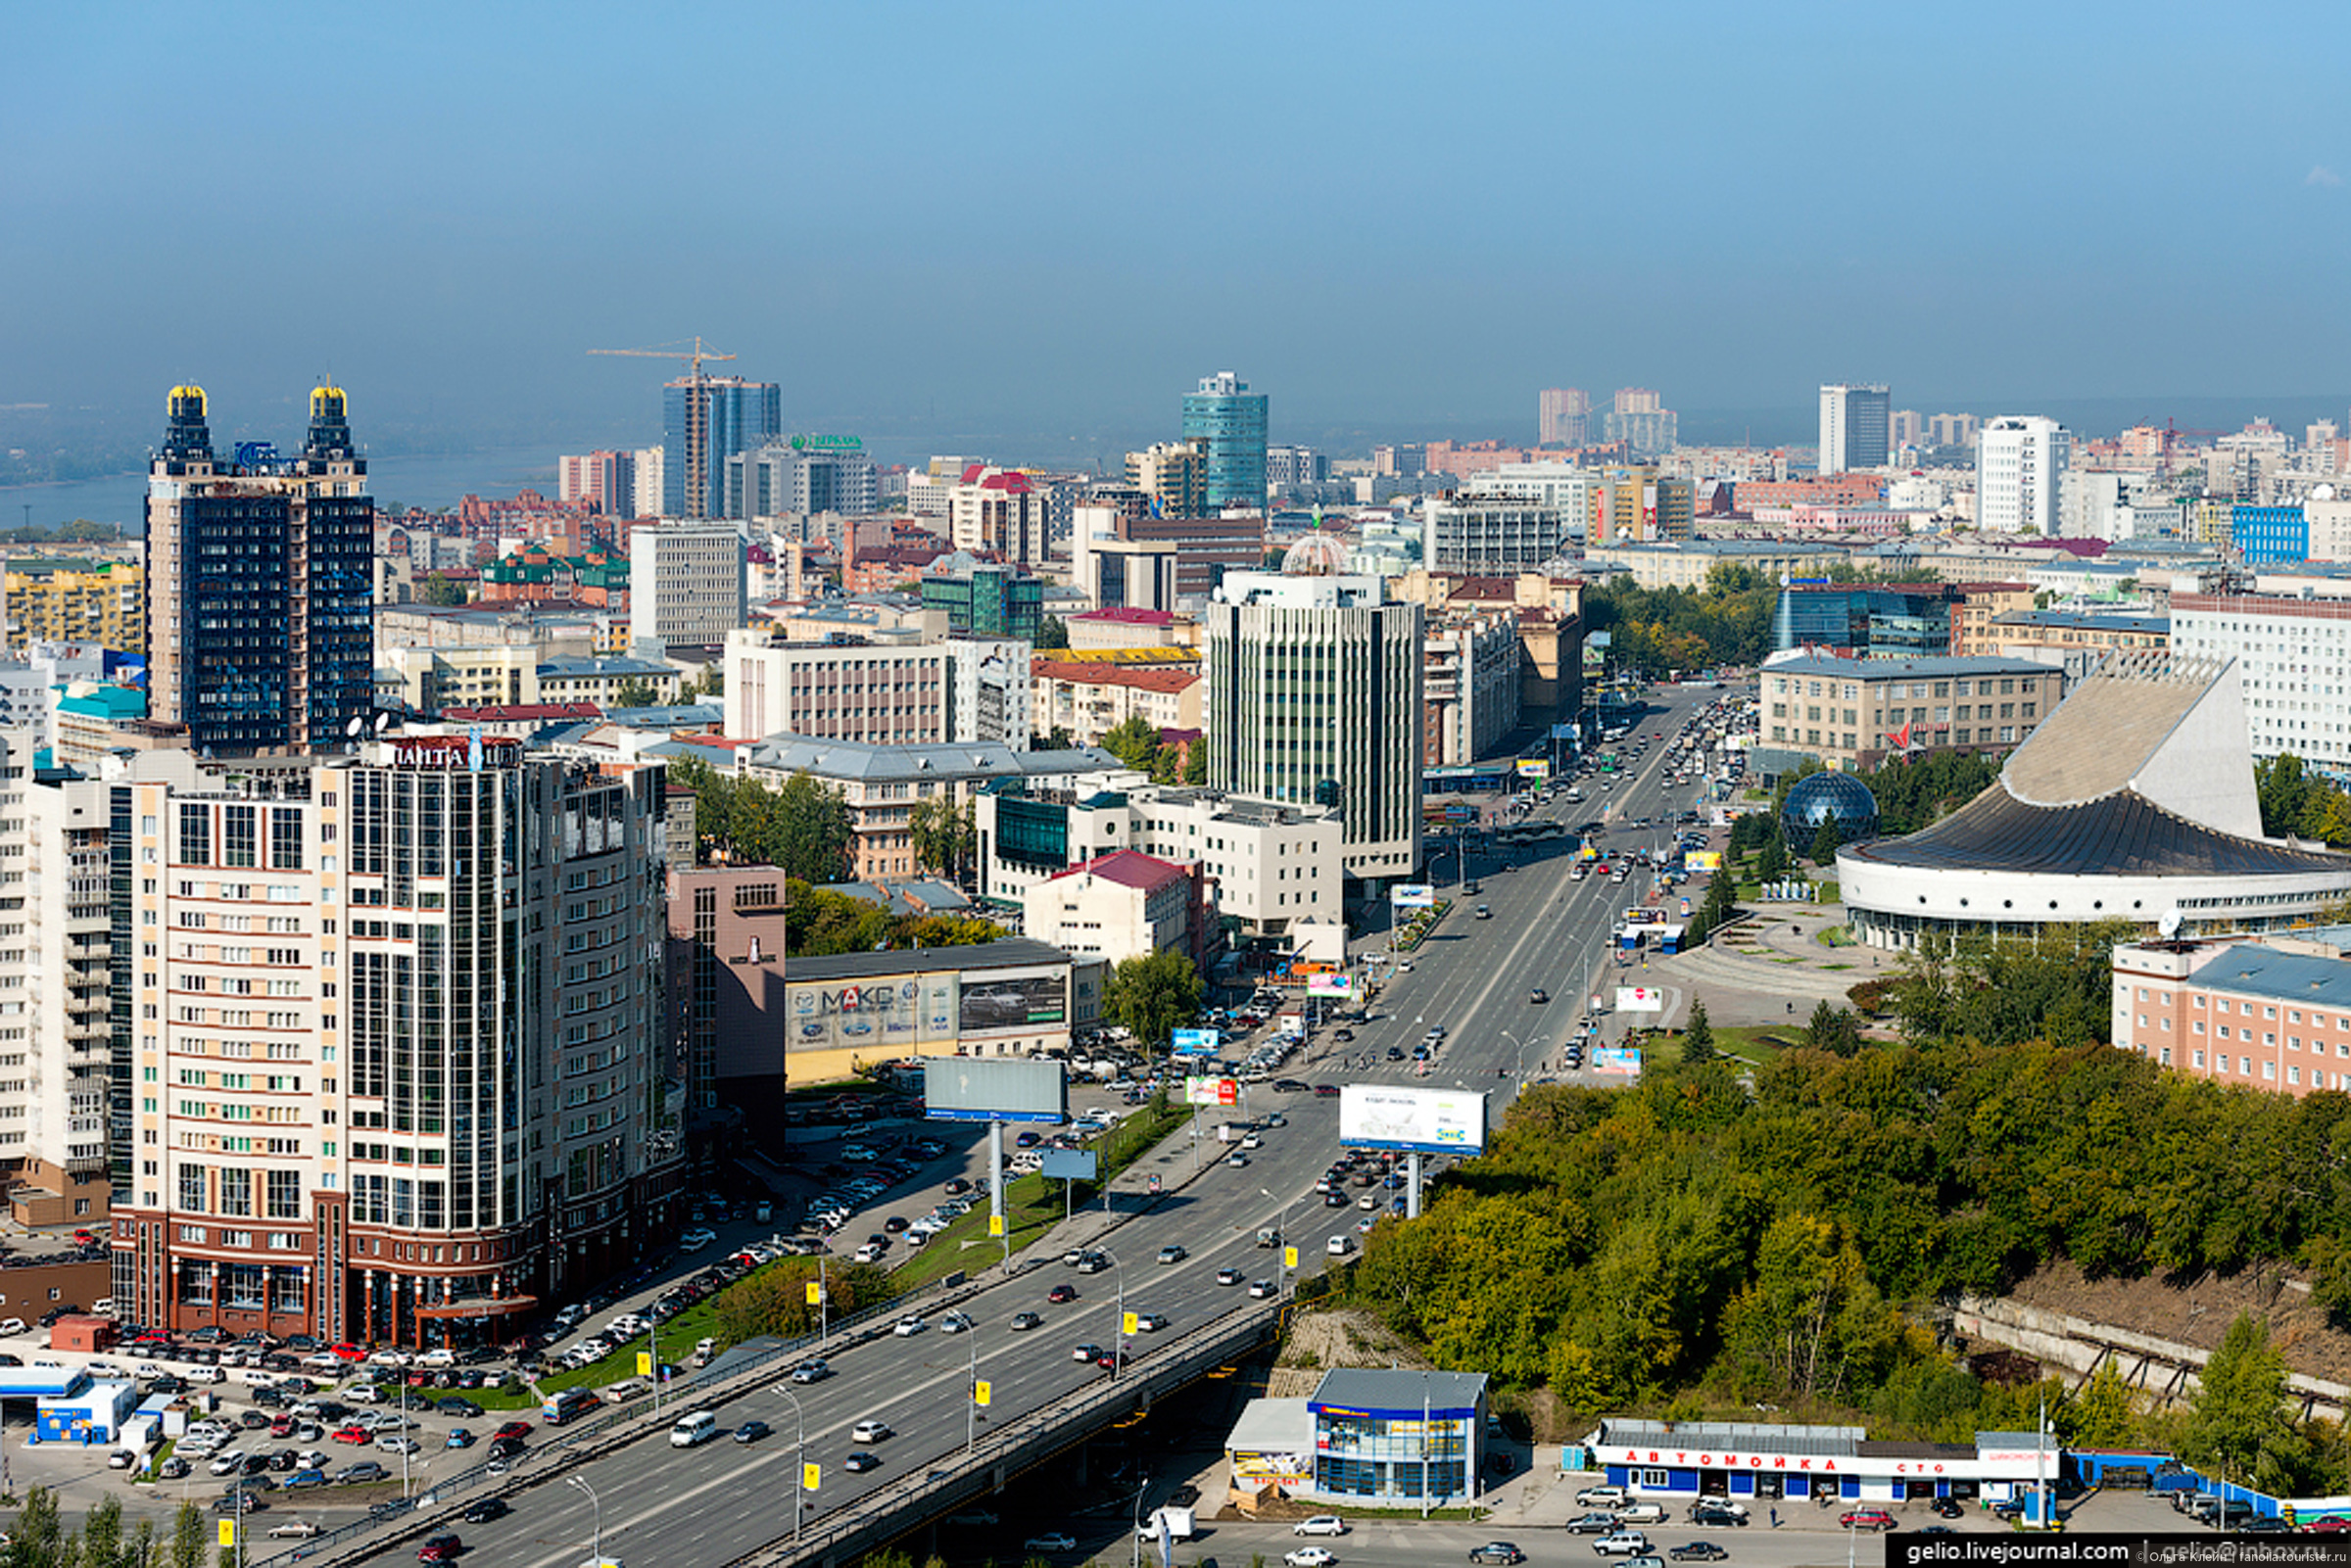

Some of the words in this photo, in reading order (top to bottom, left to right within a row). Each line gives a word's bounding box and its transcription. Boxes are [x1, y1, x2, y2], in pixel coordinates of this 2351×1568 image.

[1626, 1449, 1836, 1470] АВТОМОЙКА
[1989, 1452, 2051, 1462] ШИНОМОНТЖ
[1896, 1463, 1944, 1474] СТО
